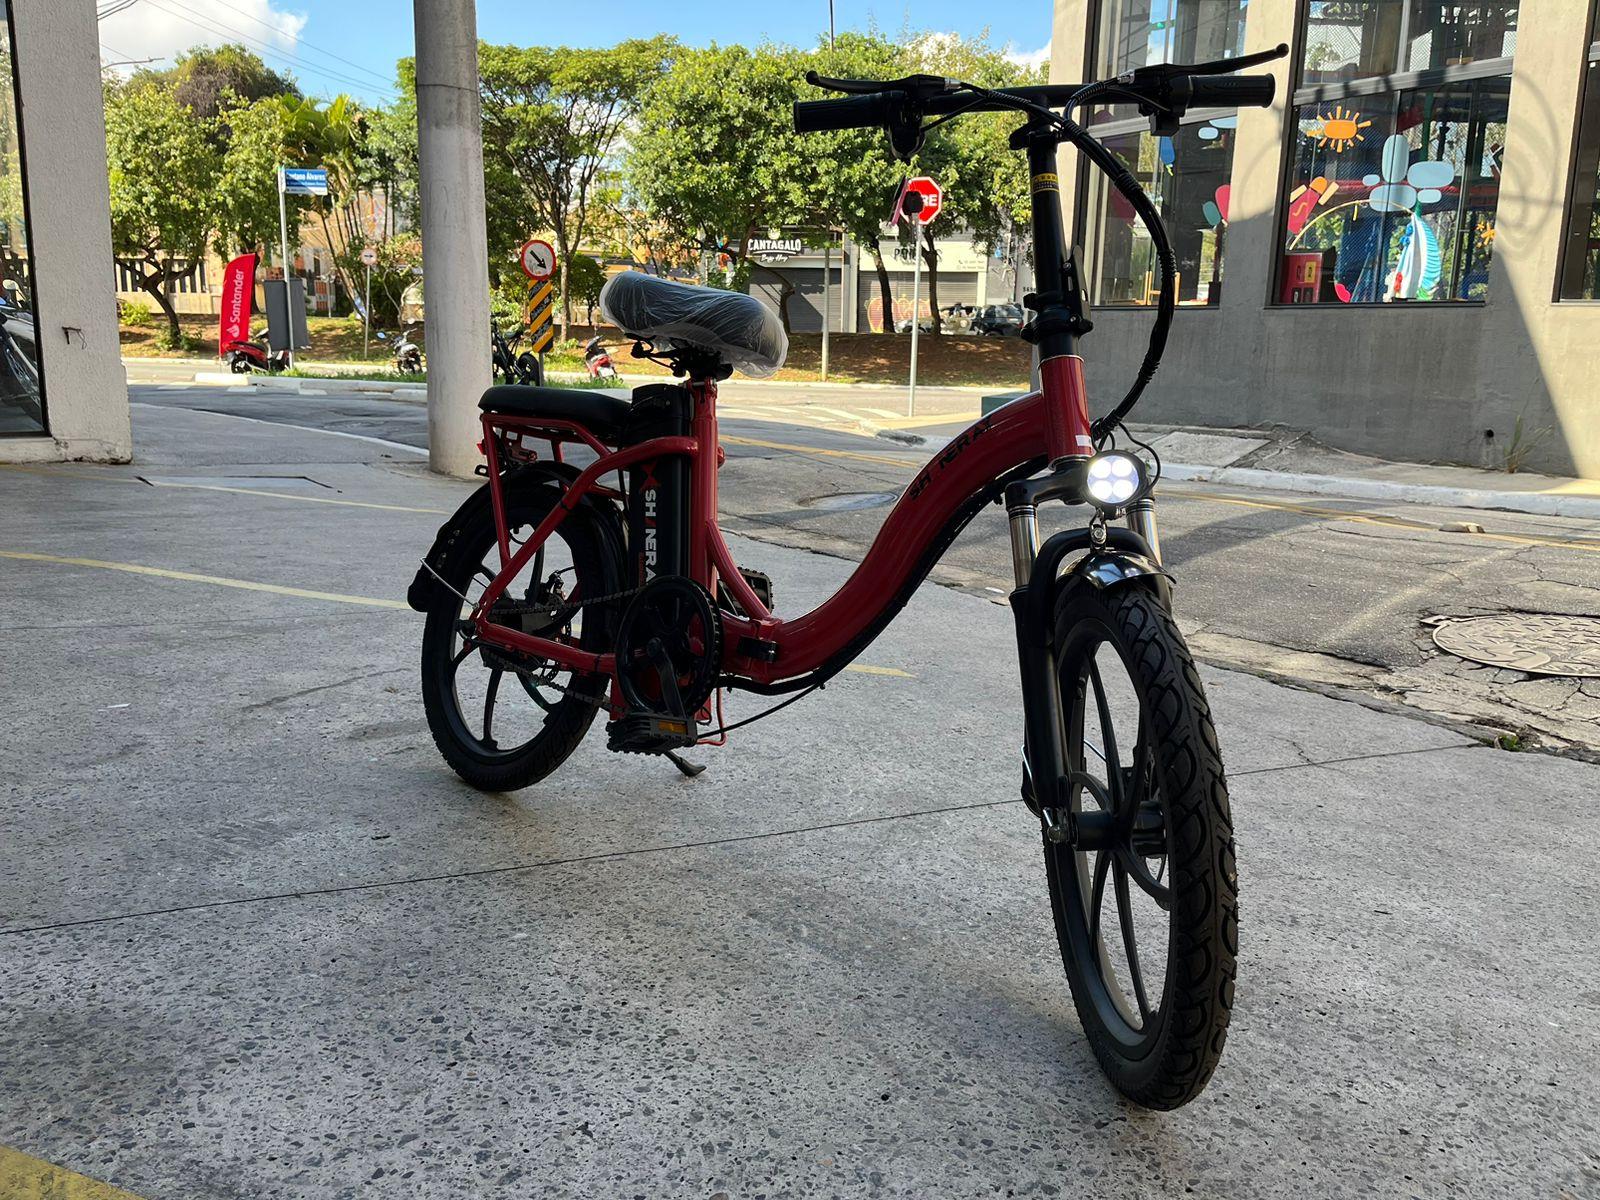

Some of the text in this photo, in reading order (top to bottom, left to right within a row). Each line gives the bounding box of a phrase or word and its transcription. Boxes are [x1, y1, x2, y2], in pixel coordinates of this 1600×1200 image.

[748, 239, 801, 251] CANTAGALO
[230, 269, 245, 323] Santander
[645, 489, 656, 585] SHINERA
